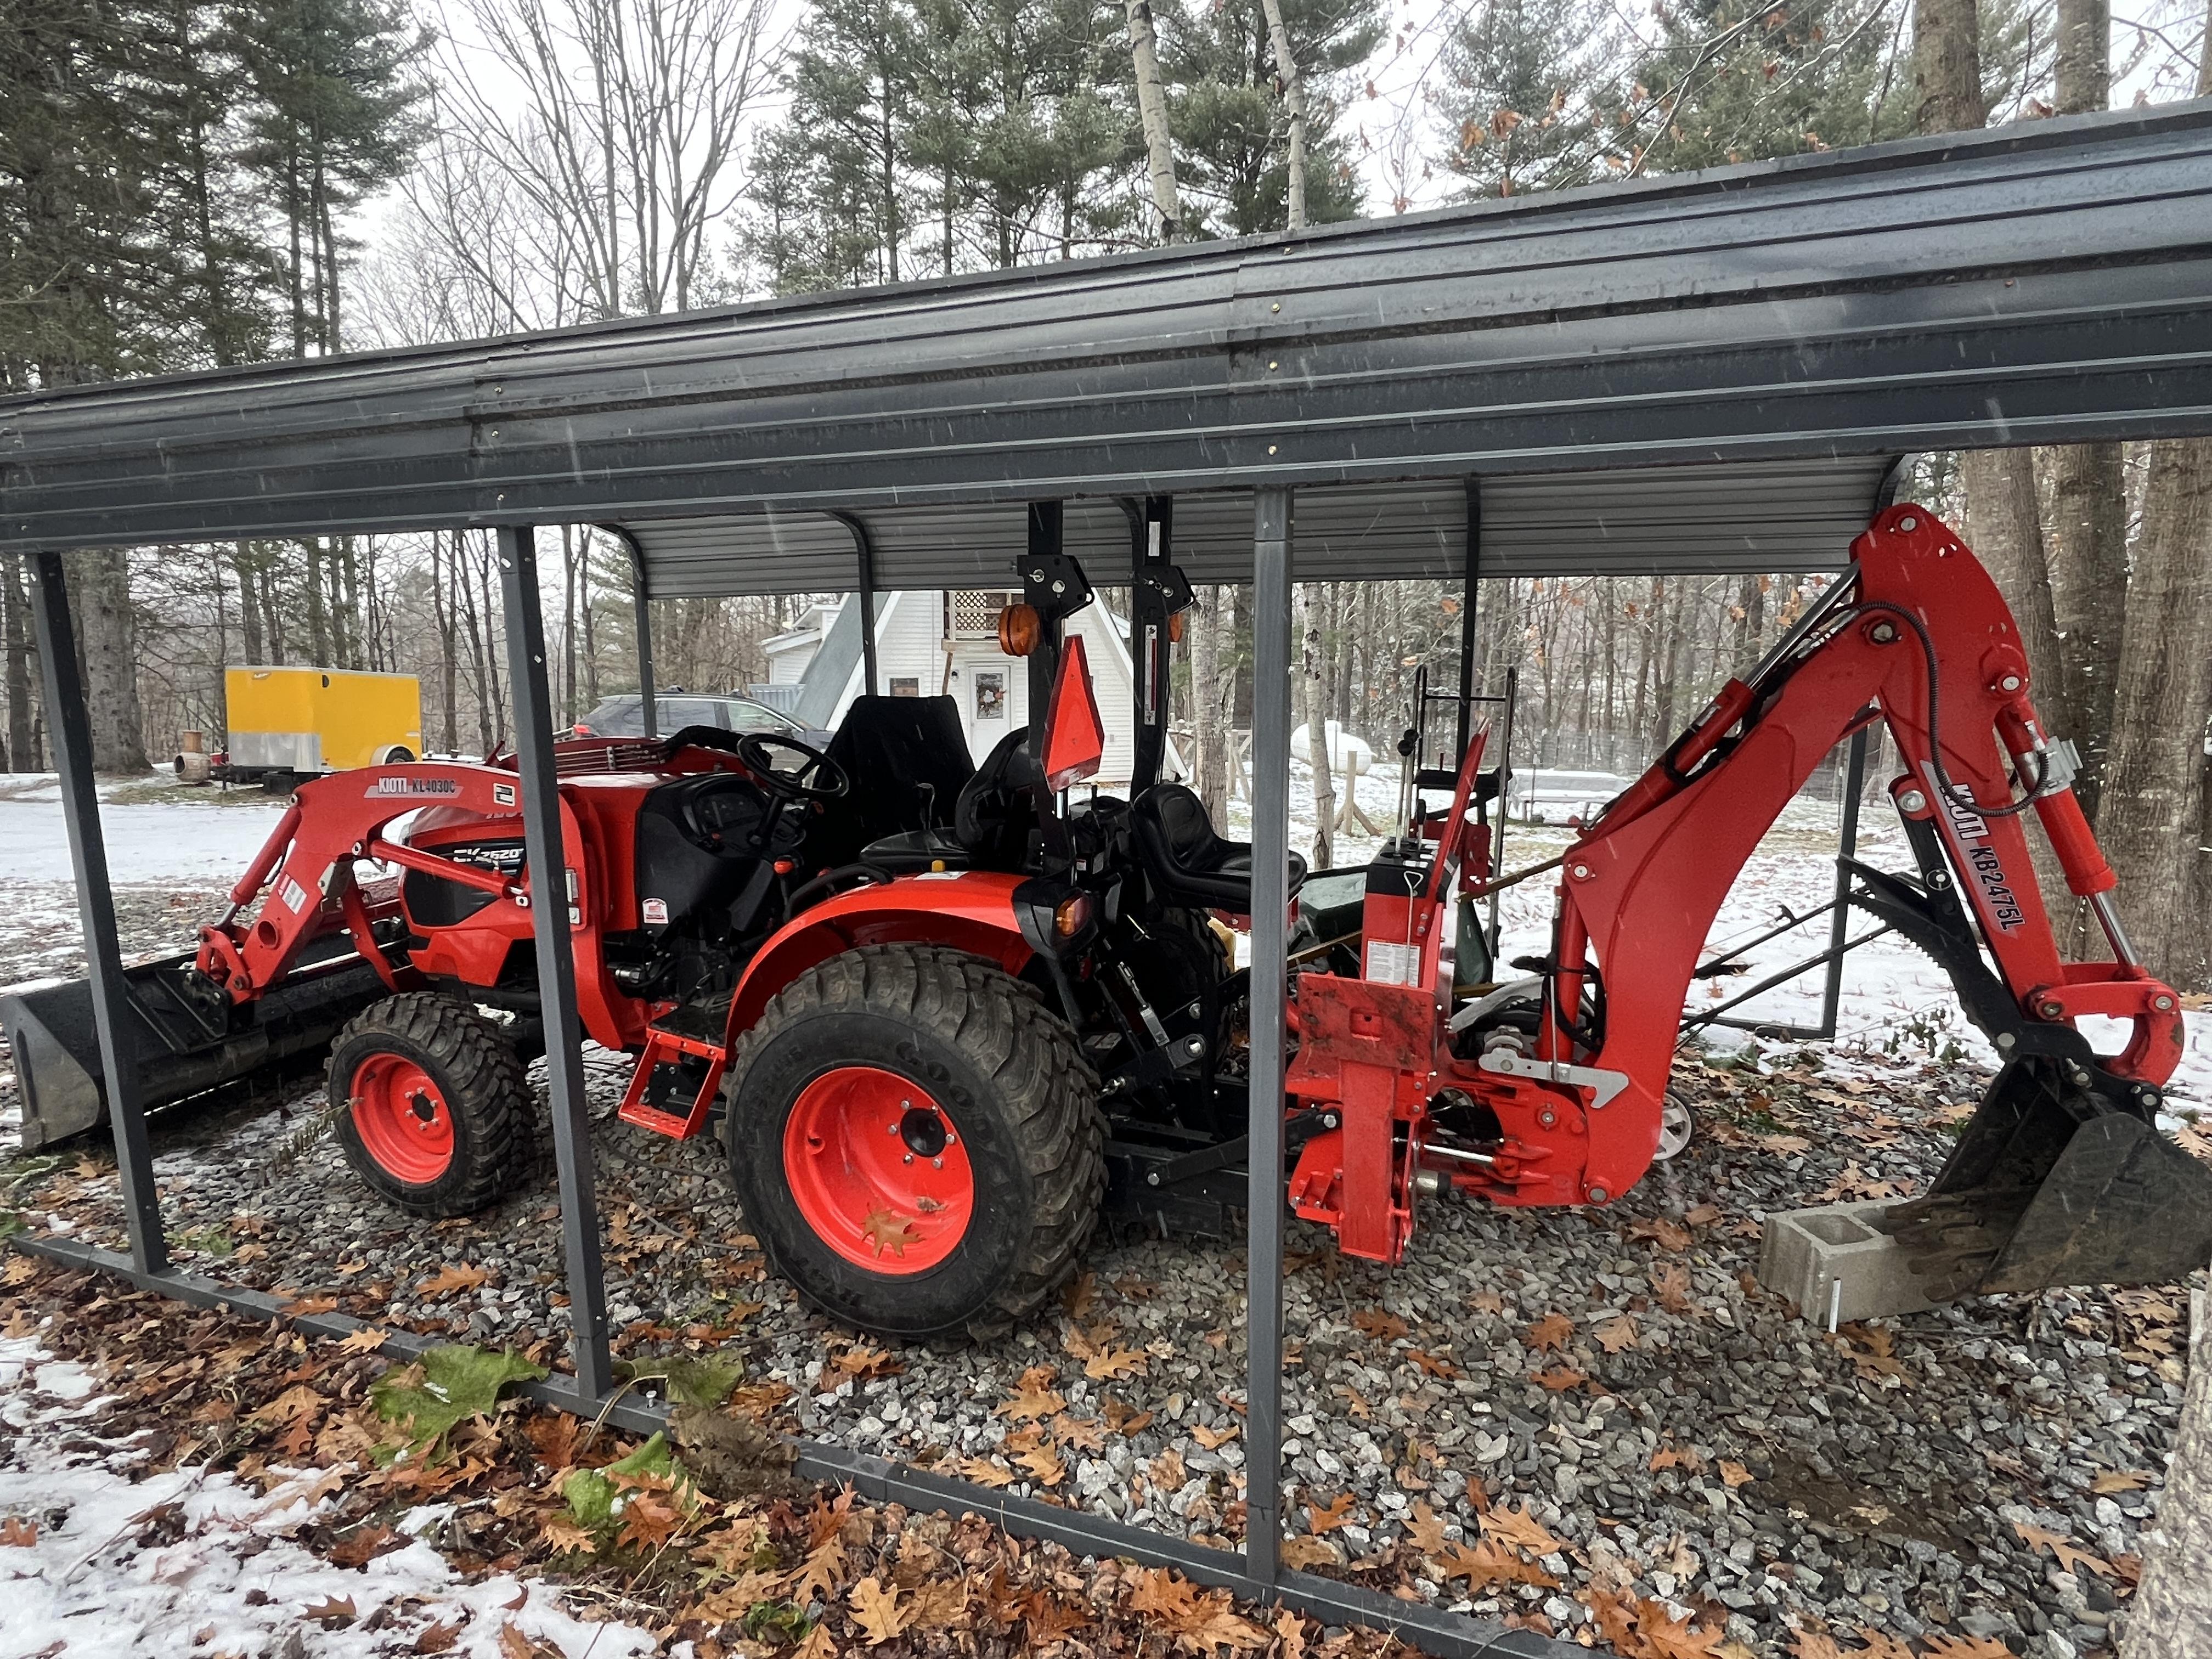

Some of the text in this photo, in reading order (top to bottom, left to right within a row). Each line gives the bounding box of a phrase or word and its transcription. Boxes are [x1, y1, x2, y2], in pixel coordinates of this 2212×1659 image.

[378, 777, 456, 794] KIOTI KL4030C
[1969, 846, 2025, 931] KB2475L
